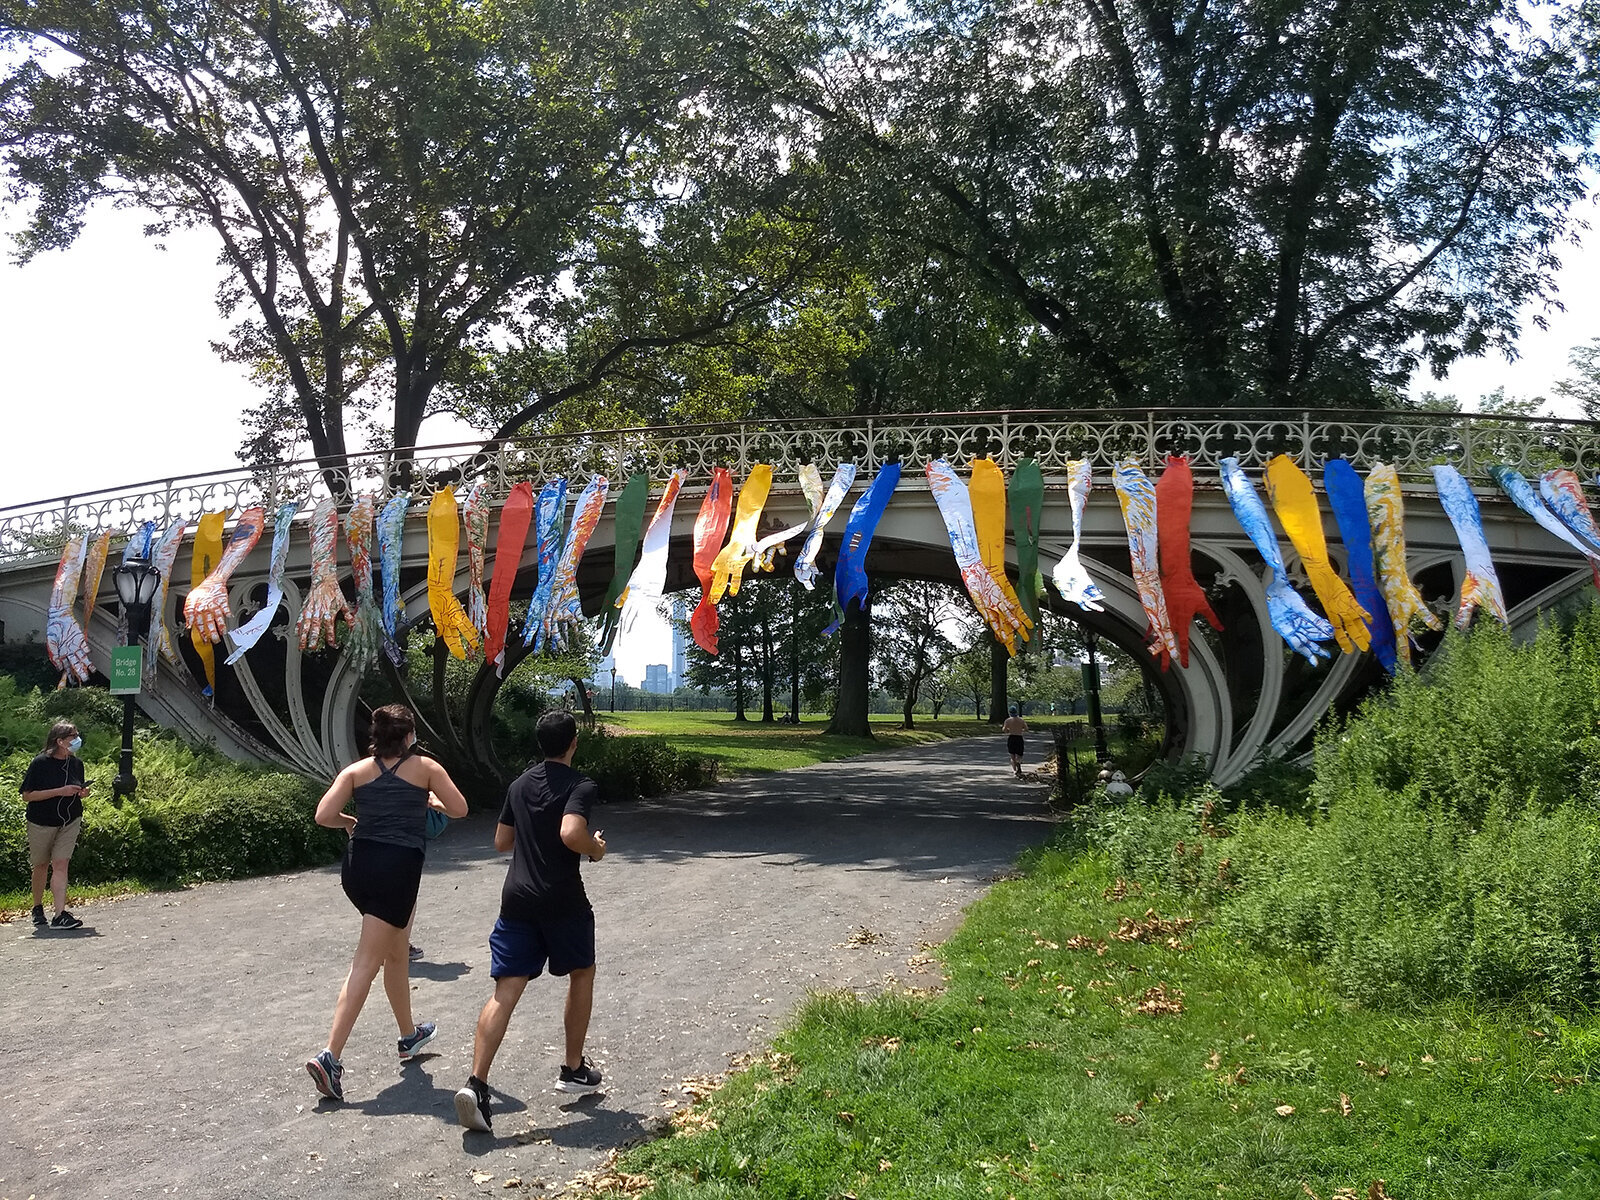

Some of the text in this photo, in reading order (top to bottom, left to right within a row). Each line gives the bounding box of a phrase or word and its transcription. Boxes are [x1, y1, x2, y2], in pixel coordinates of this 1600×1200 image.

[115, 658, 136, 667] Bridge
[115, 668, 136, 677] No. 28
